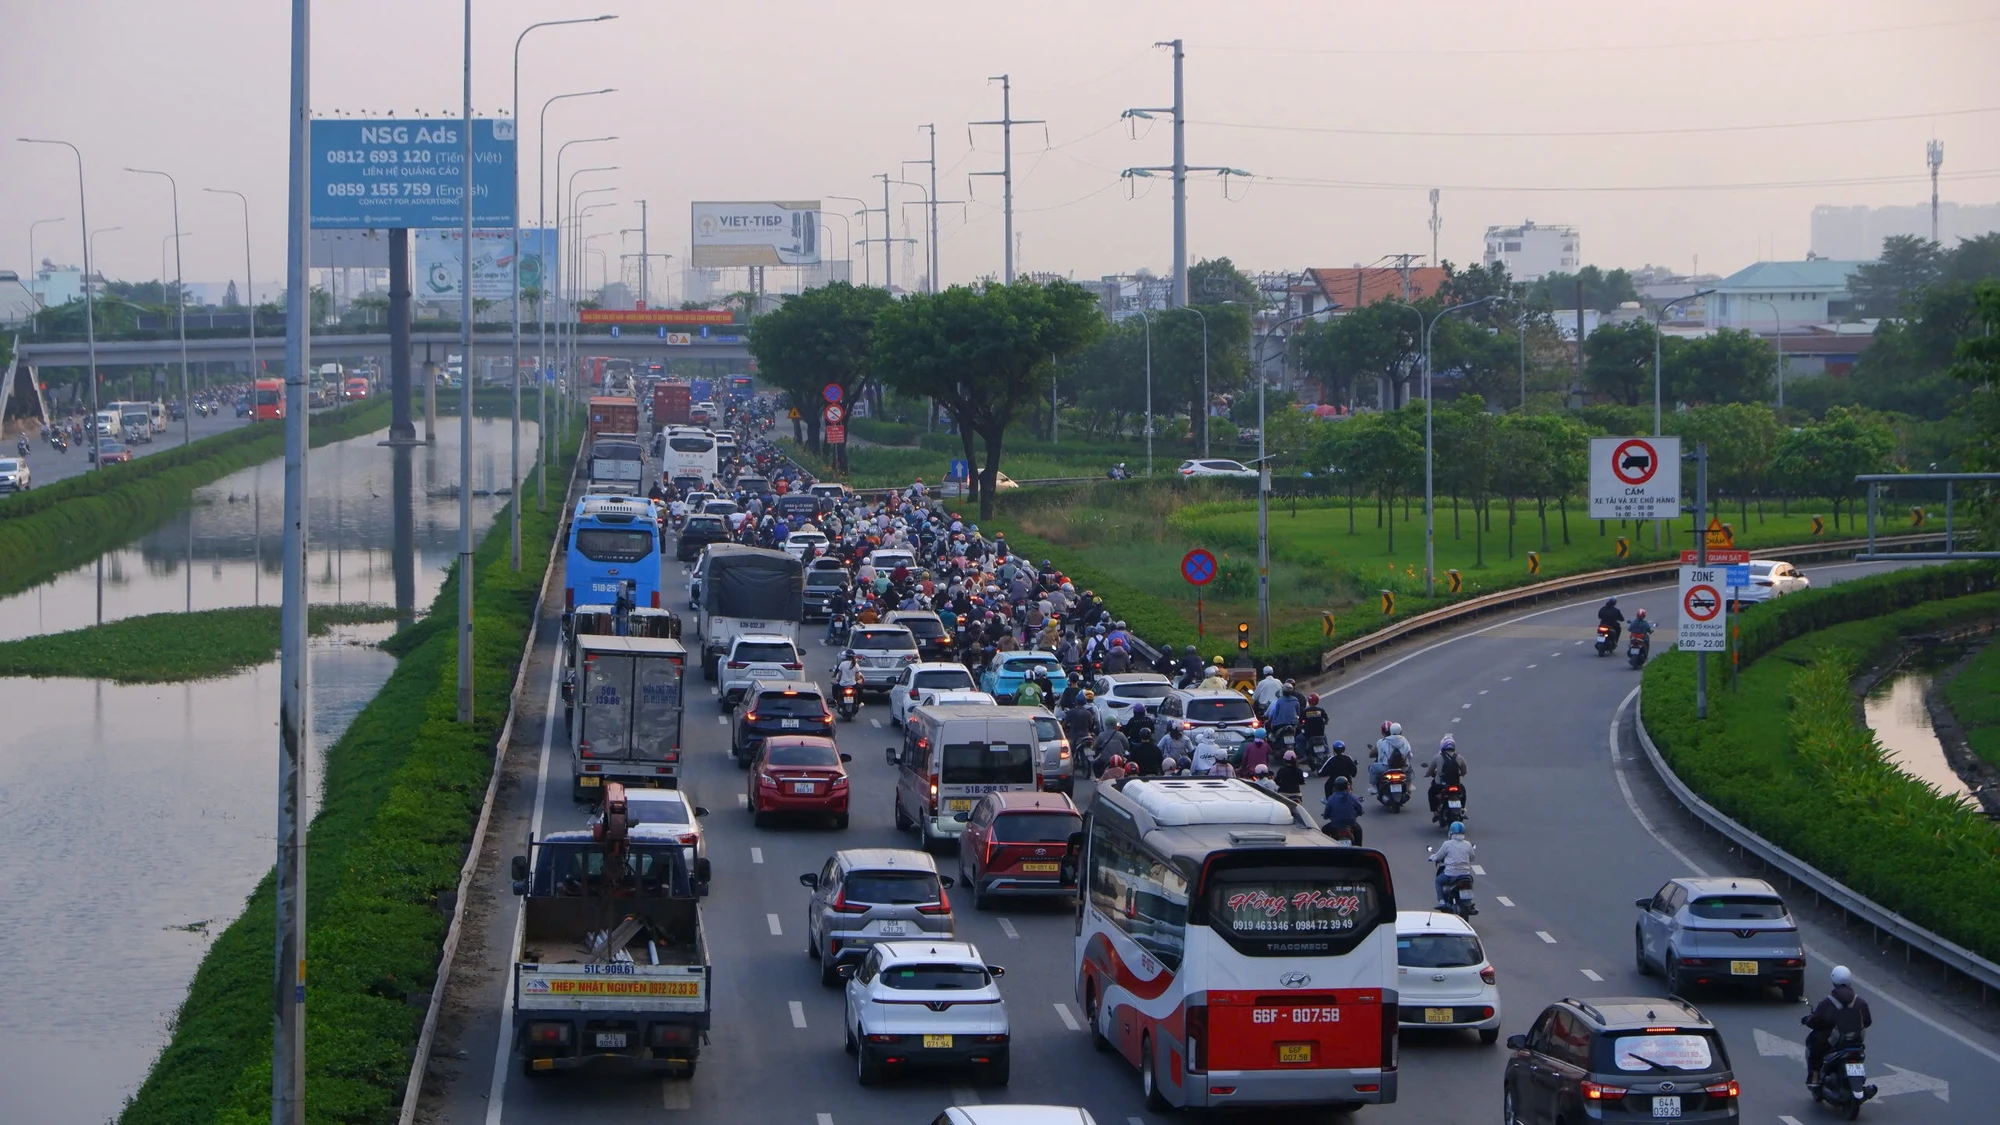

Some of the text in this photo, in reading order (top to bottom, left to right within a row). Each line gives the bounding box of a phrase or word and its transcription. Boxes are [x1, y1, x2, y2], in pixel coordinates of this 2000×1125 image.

[361, 125, 458, 144] NSG Ads
[326, 150, 365, 163] 0812
[369, 150, 398, 163] 693
[403, 150, 431, 163] 120
[362, 166, 383, 176] LIÊN
[386, 166, 399, 178] HỆ
[326, 183, 488, 198] 0859 155 759 (Engsh)
[358, 198, 460, 206] CONTACT FOR ADVERTISING
[1625, 486, 1645, 496] CẤM
[1618, 496, 1628, 504] VÀ
[1691, 571, 1715, 582] ZONE
[1228, 889, 1360, 917] Hồng Hoàng
[1232, 920, 1254, 931] 0919
[1295, 920, 1316, 931] 0984
[1317, 919, 1328, 930] 72
[1330, 919, 1341, 930] 39
[1342, 918, 1353, 929] 49
[551, 980, 576, 992] THÉP
[578, 980, 605, 994] NHẬT
[649, 982, 667, 994] 0972
[668, 983, 678, 994] 72
[679, 983, 688, 994] 33
[688, 983, 698, 994] 33
[1253, 1008, 1278, 1024] 66F
[1292, 1008, 1340, 1023] 007.58
[1659, 1097, 1674, 1107] 64A
